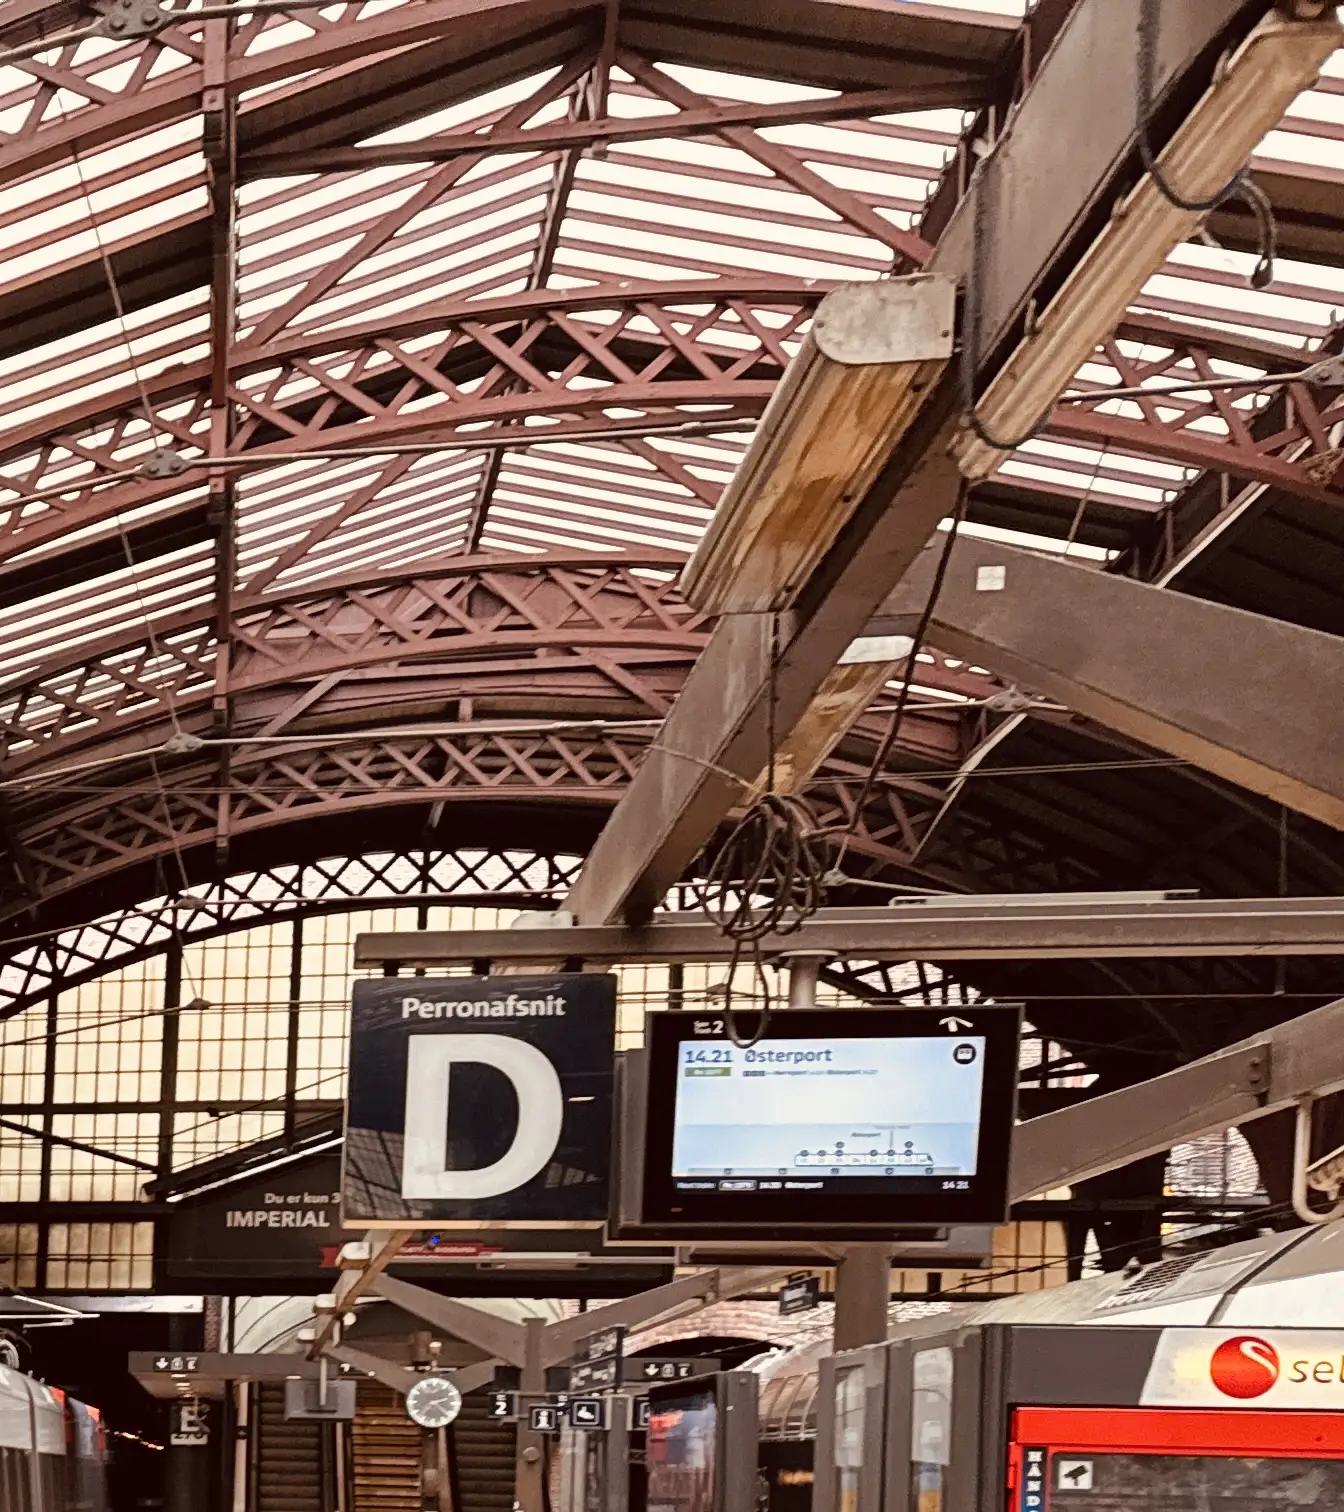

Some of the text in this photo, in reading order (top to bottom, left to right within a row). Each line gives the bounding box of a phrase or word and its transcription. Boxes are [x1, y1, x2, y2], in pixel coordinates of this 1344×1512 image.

[401, 995, 567, 1019] Perronafsnit
[712, 1020, 724, 1034] 2
[685, 1049, 833, 1065] 14.21 Østerport
[401, 1033, 563, 1200] D
[264, 1193, 283, 1204] Du
[226, 1210, 331, 1228] IMPERIAL
[495, 1401, 507, 1415] 2
